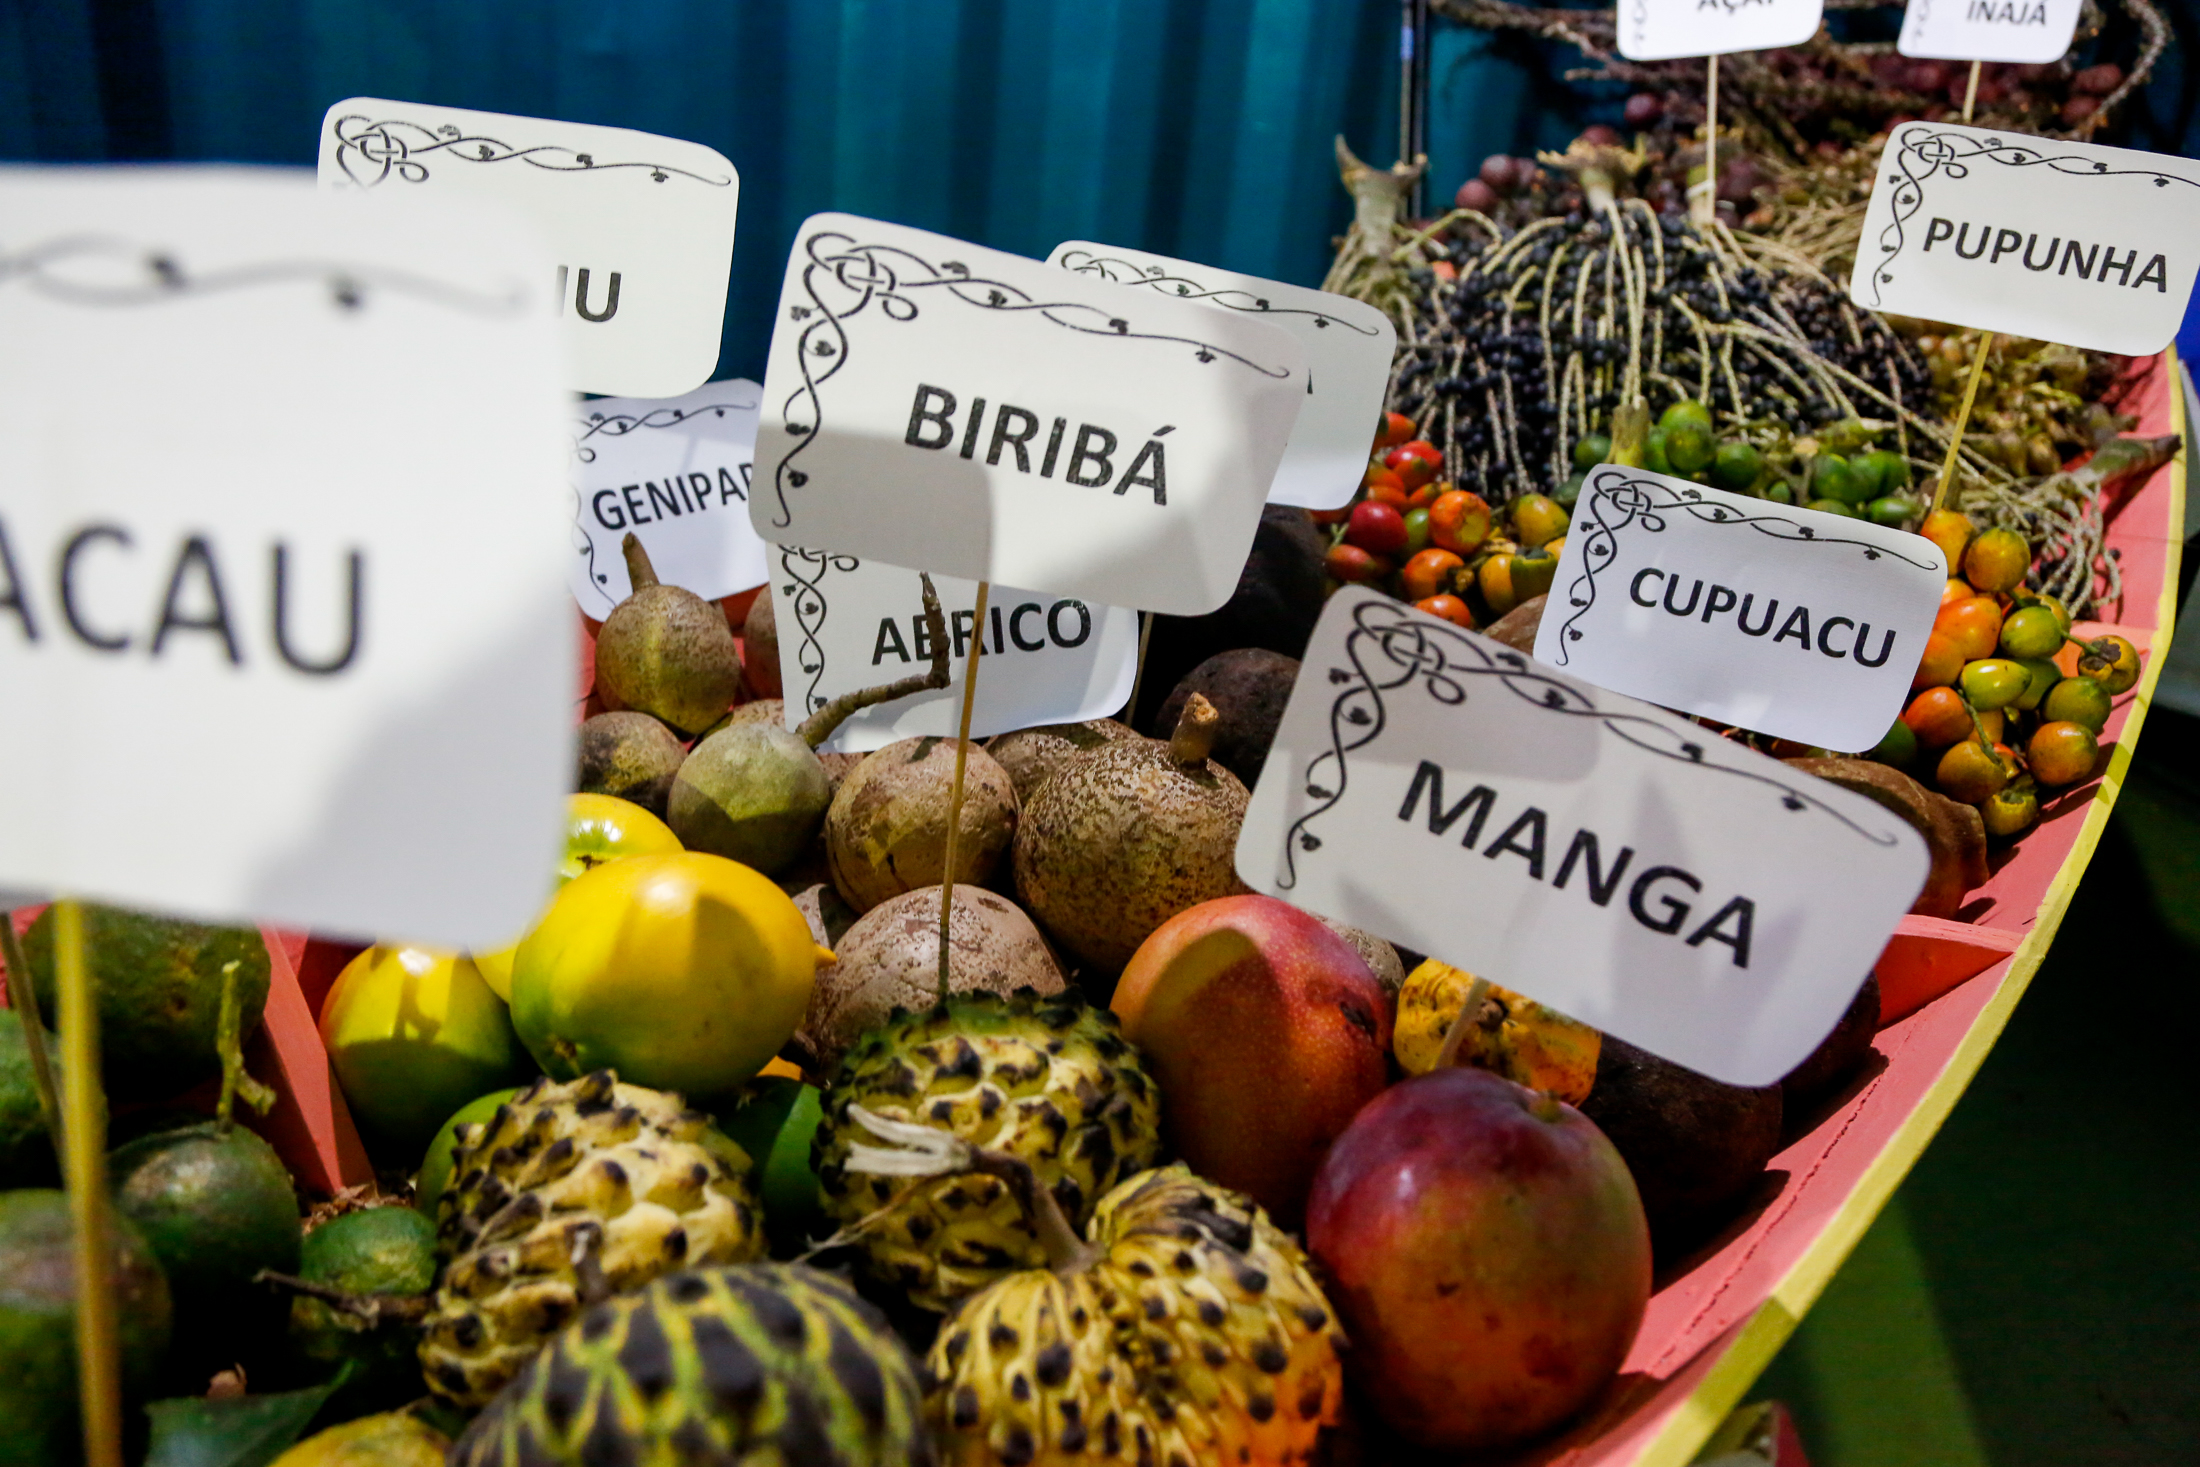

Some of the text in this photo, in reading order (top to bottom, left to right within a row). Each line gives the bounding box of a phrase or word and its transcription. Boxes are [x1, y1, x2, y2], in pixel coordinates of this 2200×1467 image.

[1922, 216, 2167, 294] PUPUNHA
[904, 382, 1177, 507] BIRIBÁ
[1629, 567, 1897, 669] CUPUACU
[1397, 758, 1756, 971] MANGA
